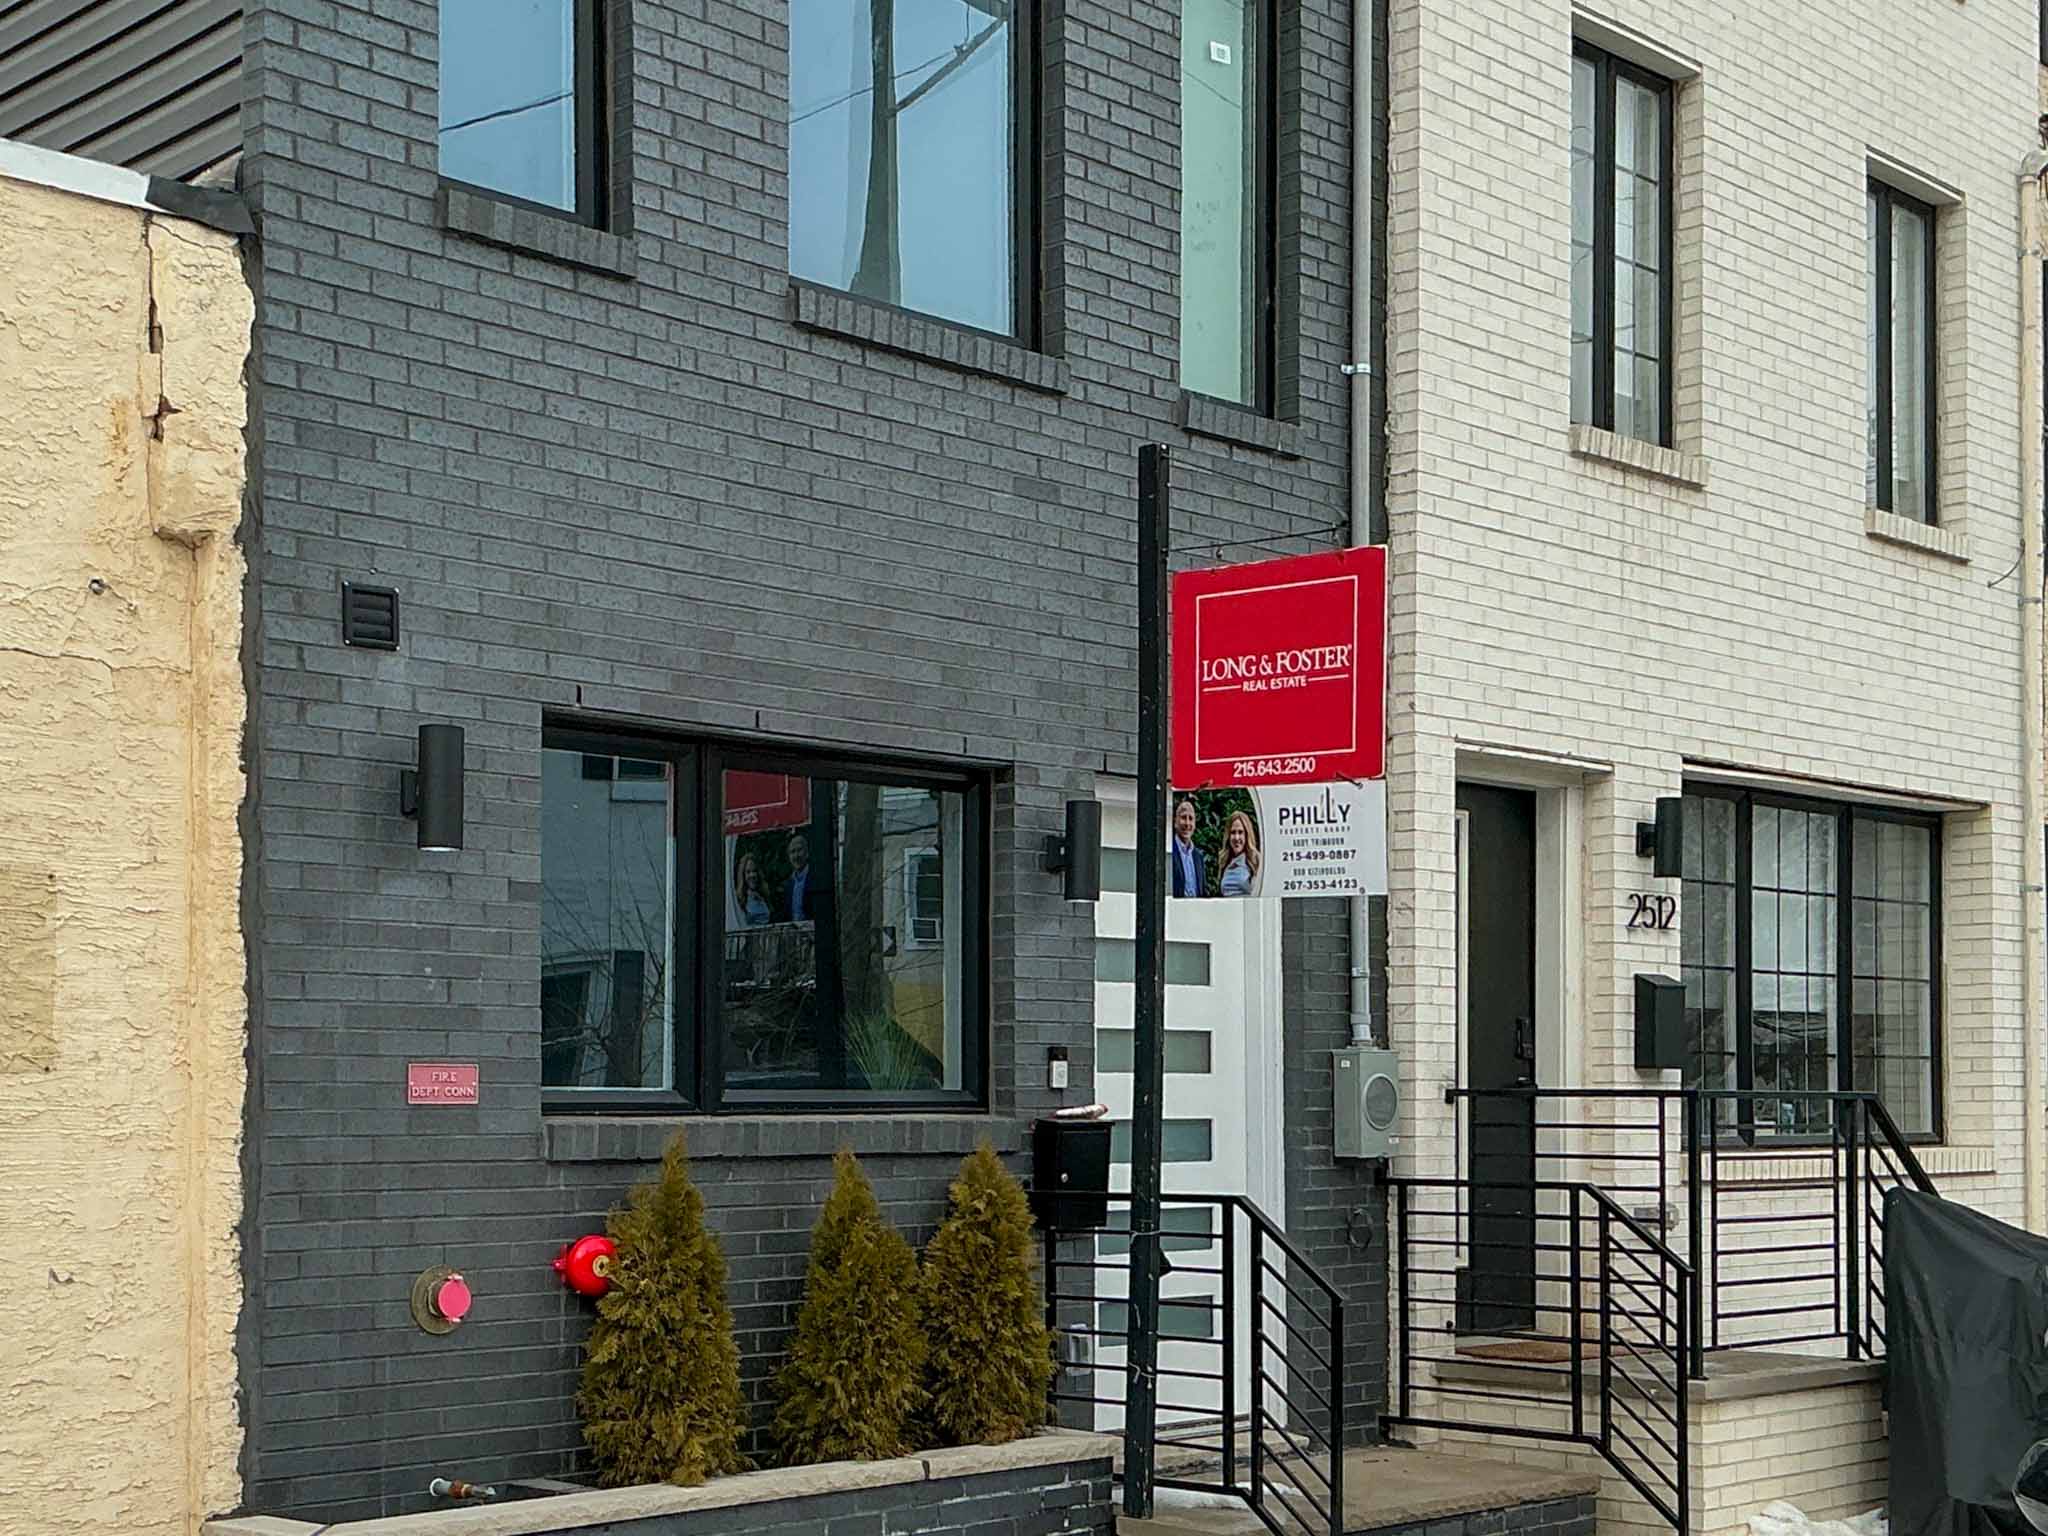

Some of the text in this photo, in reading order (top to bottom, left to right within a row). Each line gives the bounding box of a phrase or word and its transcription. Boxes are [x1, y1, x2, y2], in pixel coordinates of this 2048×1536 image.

[1202, 644, 1351, 682] LONG & FOSTER
[1242, 675, 1307, 692] REAL ESTATE
[1233, 756, 1316, 778] 215.643.2500
[1278, 786, 1351, 825] PHILLY
[1283, 878, 1358, 890] 267-353-4123
[1626, 893, 1676, 930] 2512
[431, 1071, 457, 1082] FIRE
[411, 1086, 475, 1098] DEPT CONN
